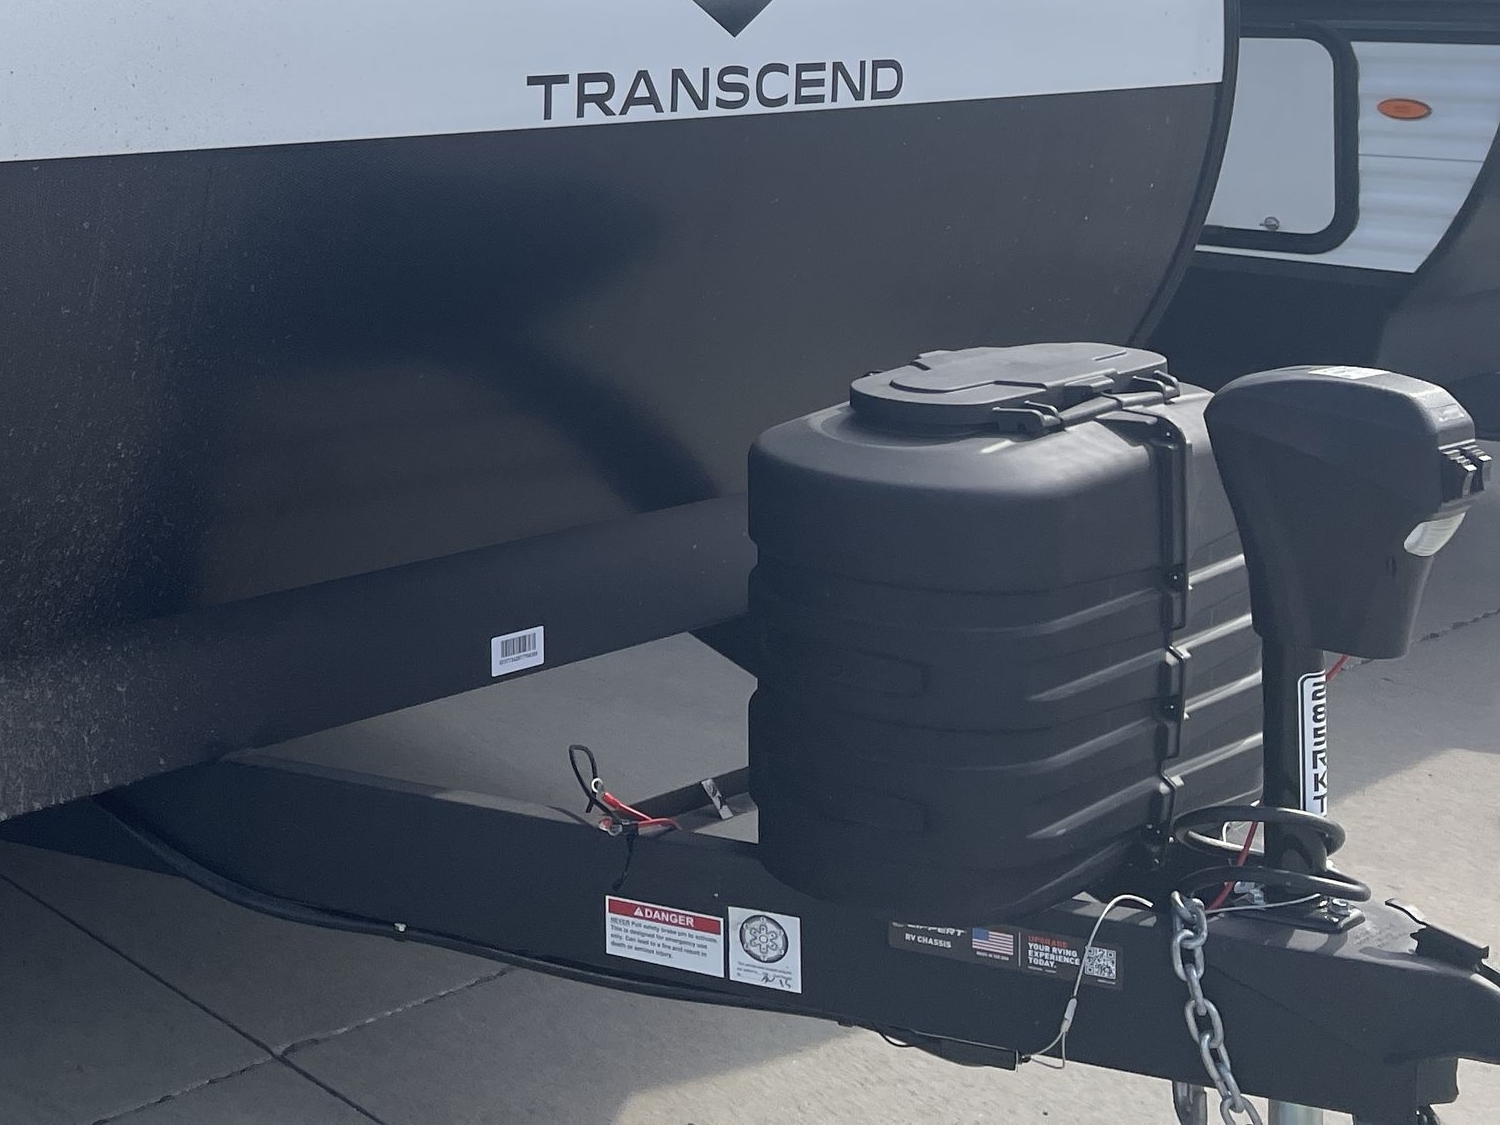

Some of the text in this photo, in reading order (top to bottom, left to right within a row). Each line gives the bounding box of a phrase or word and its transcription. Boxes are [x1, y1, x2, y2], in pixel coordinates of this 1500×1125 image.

[526, 58, 903, 121] TRANSCEND
[644, 908, 694, 927] DANGER
[905, 933, 952, 948] RV CHASSIS
[1028, 935, 1069, 947] UPGRADE
[1028, 942, 1078, 957] YOUR RVING
[1028, 950, 1080, 966] EXPERIENCE
[1028, 957, 1057, 968] TODAY.
